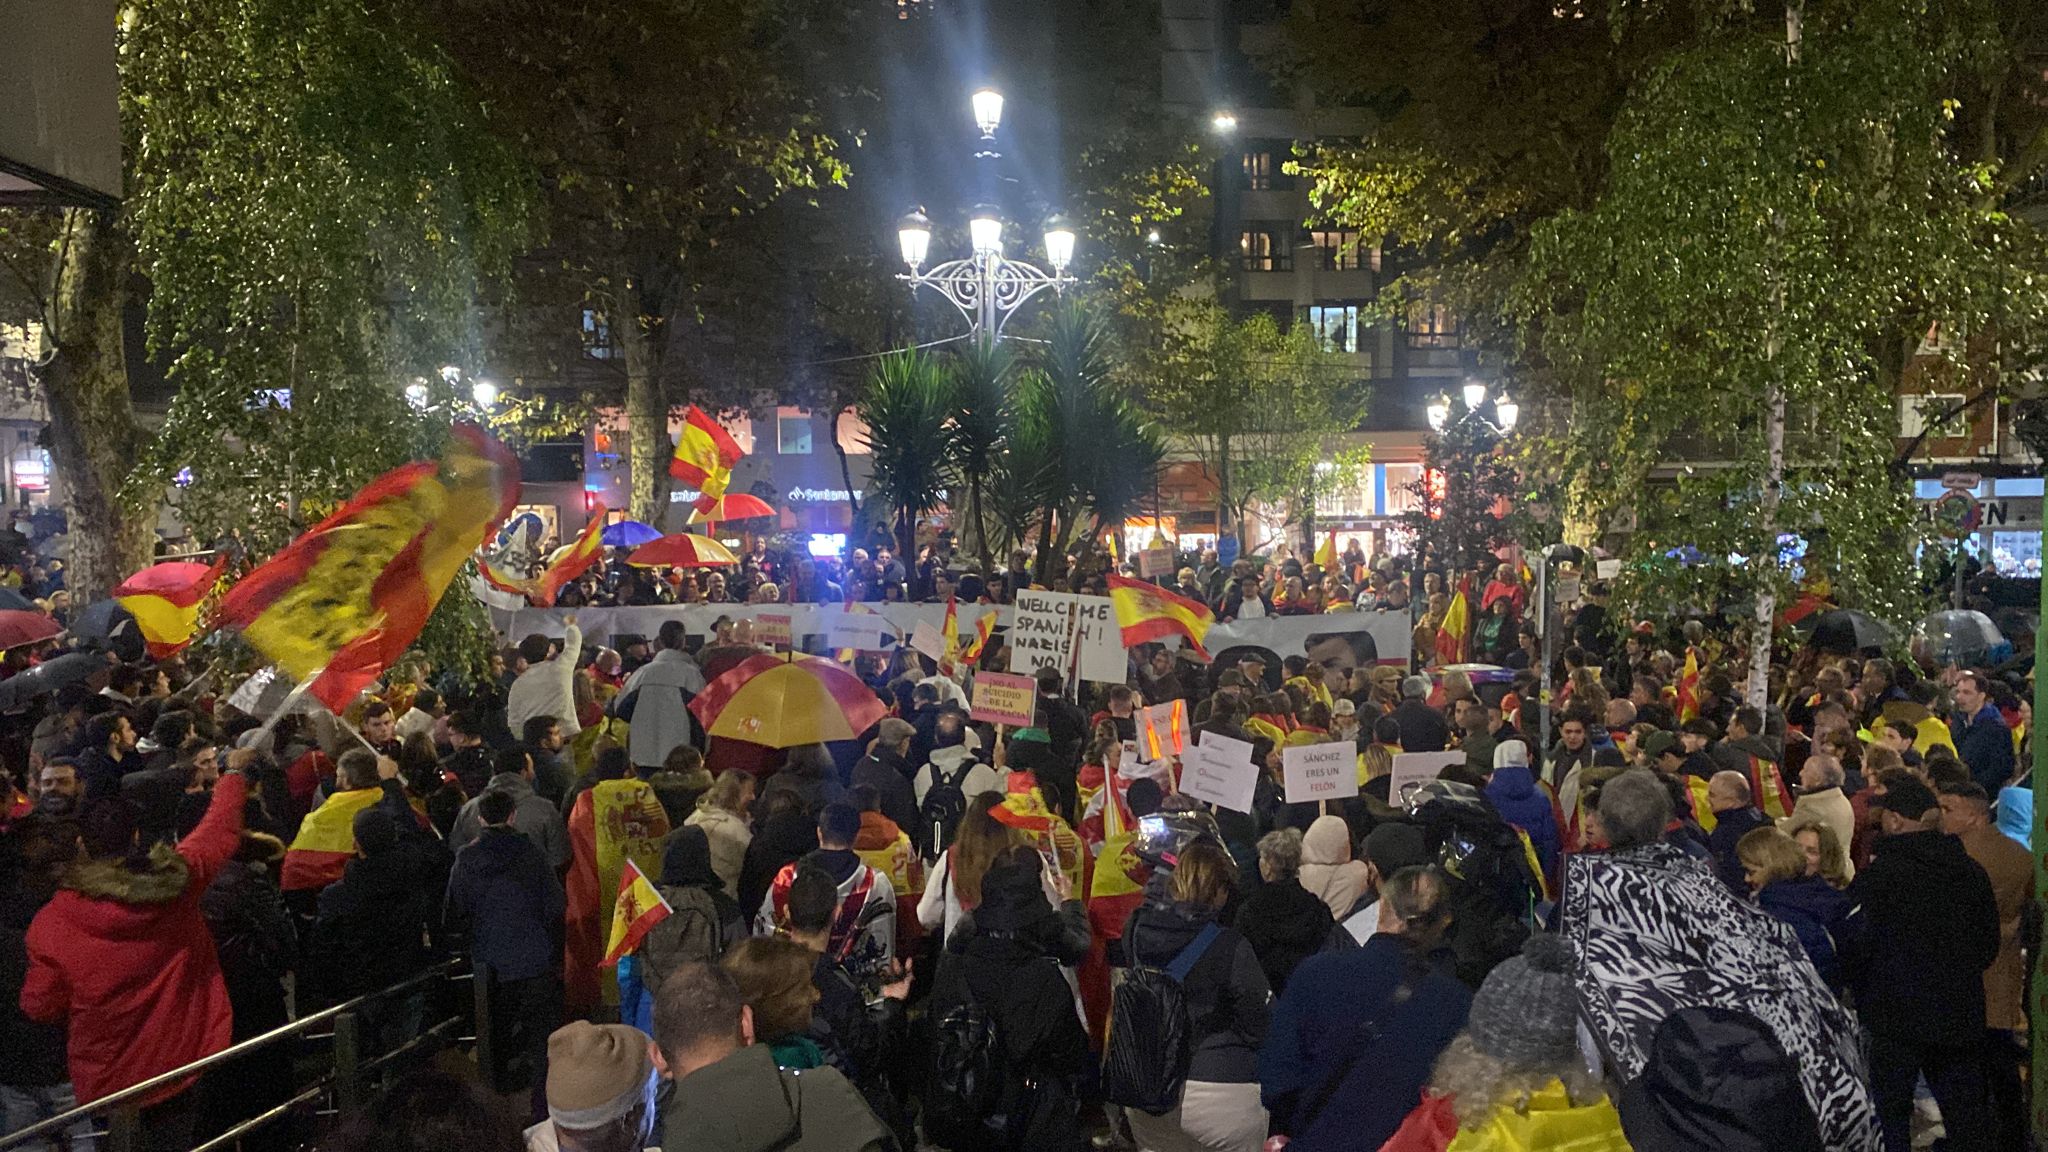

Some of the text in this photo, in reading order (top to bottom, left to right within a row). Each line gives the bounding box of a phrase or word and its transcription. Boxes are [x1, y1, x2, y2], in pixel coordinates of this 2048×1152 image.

[1017, 598, 1110, 620] WELLCOME
[989, 698, 1013, 708] DE LA
[1305, 767, 1339, 778] ERES UN
